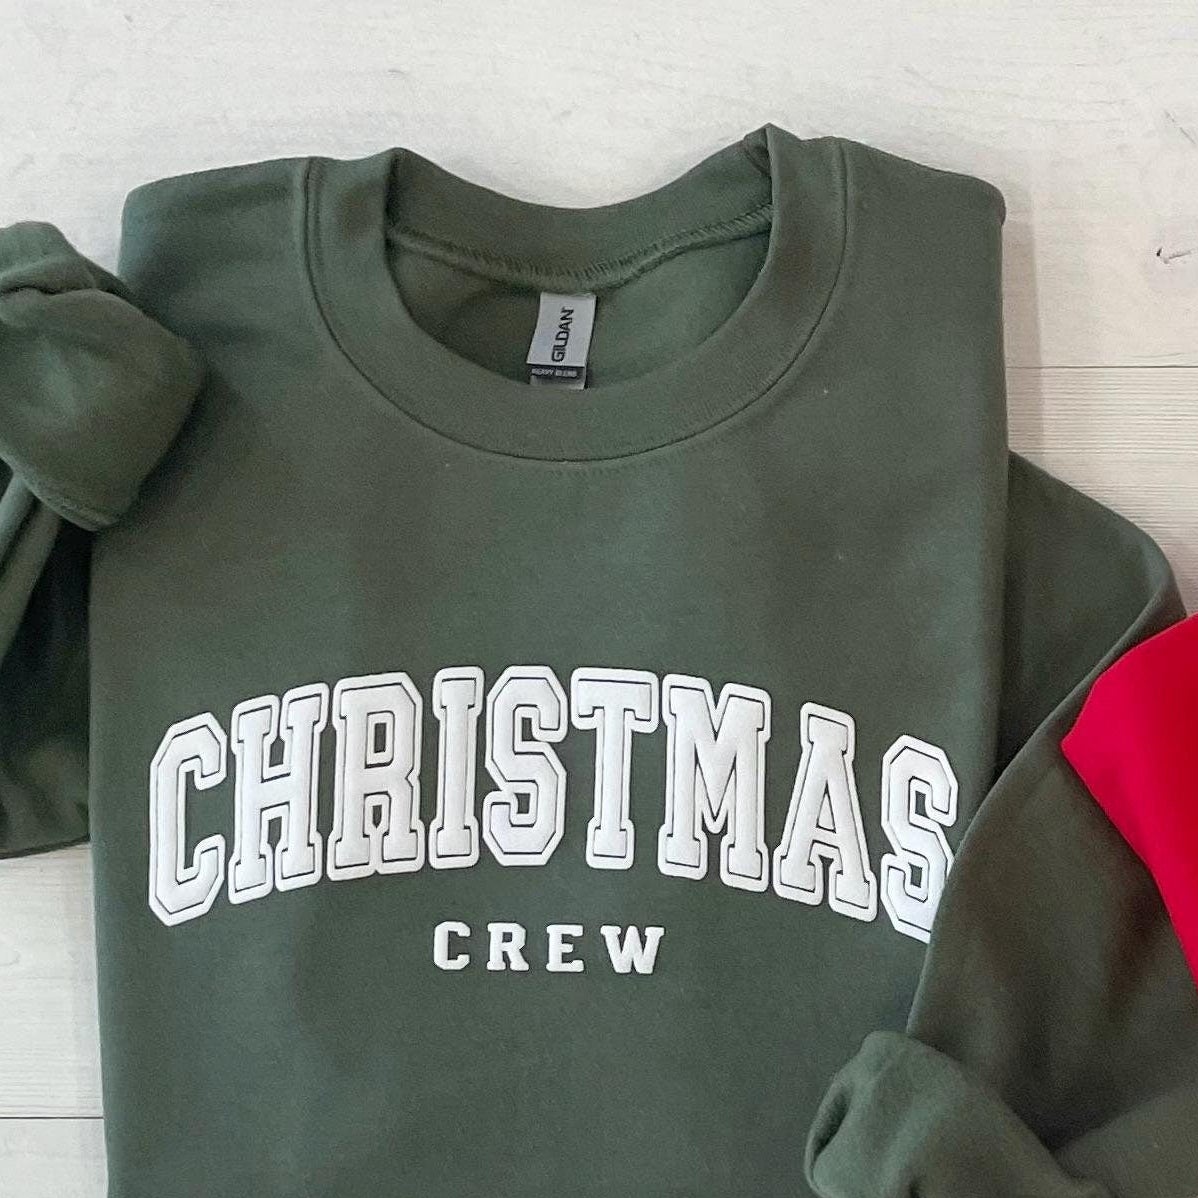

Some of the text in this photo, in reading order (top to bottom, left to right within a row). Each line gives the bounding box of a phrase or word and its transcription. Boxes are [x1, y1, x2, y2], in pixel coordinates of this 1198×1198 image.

[551, 308, 575, 363] GILDAN
[149, 666, 959, 944] CHRISTMAS
[433, 921, 665, 974] CREW
